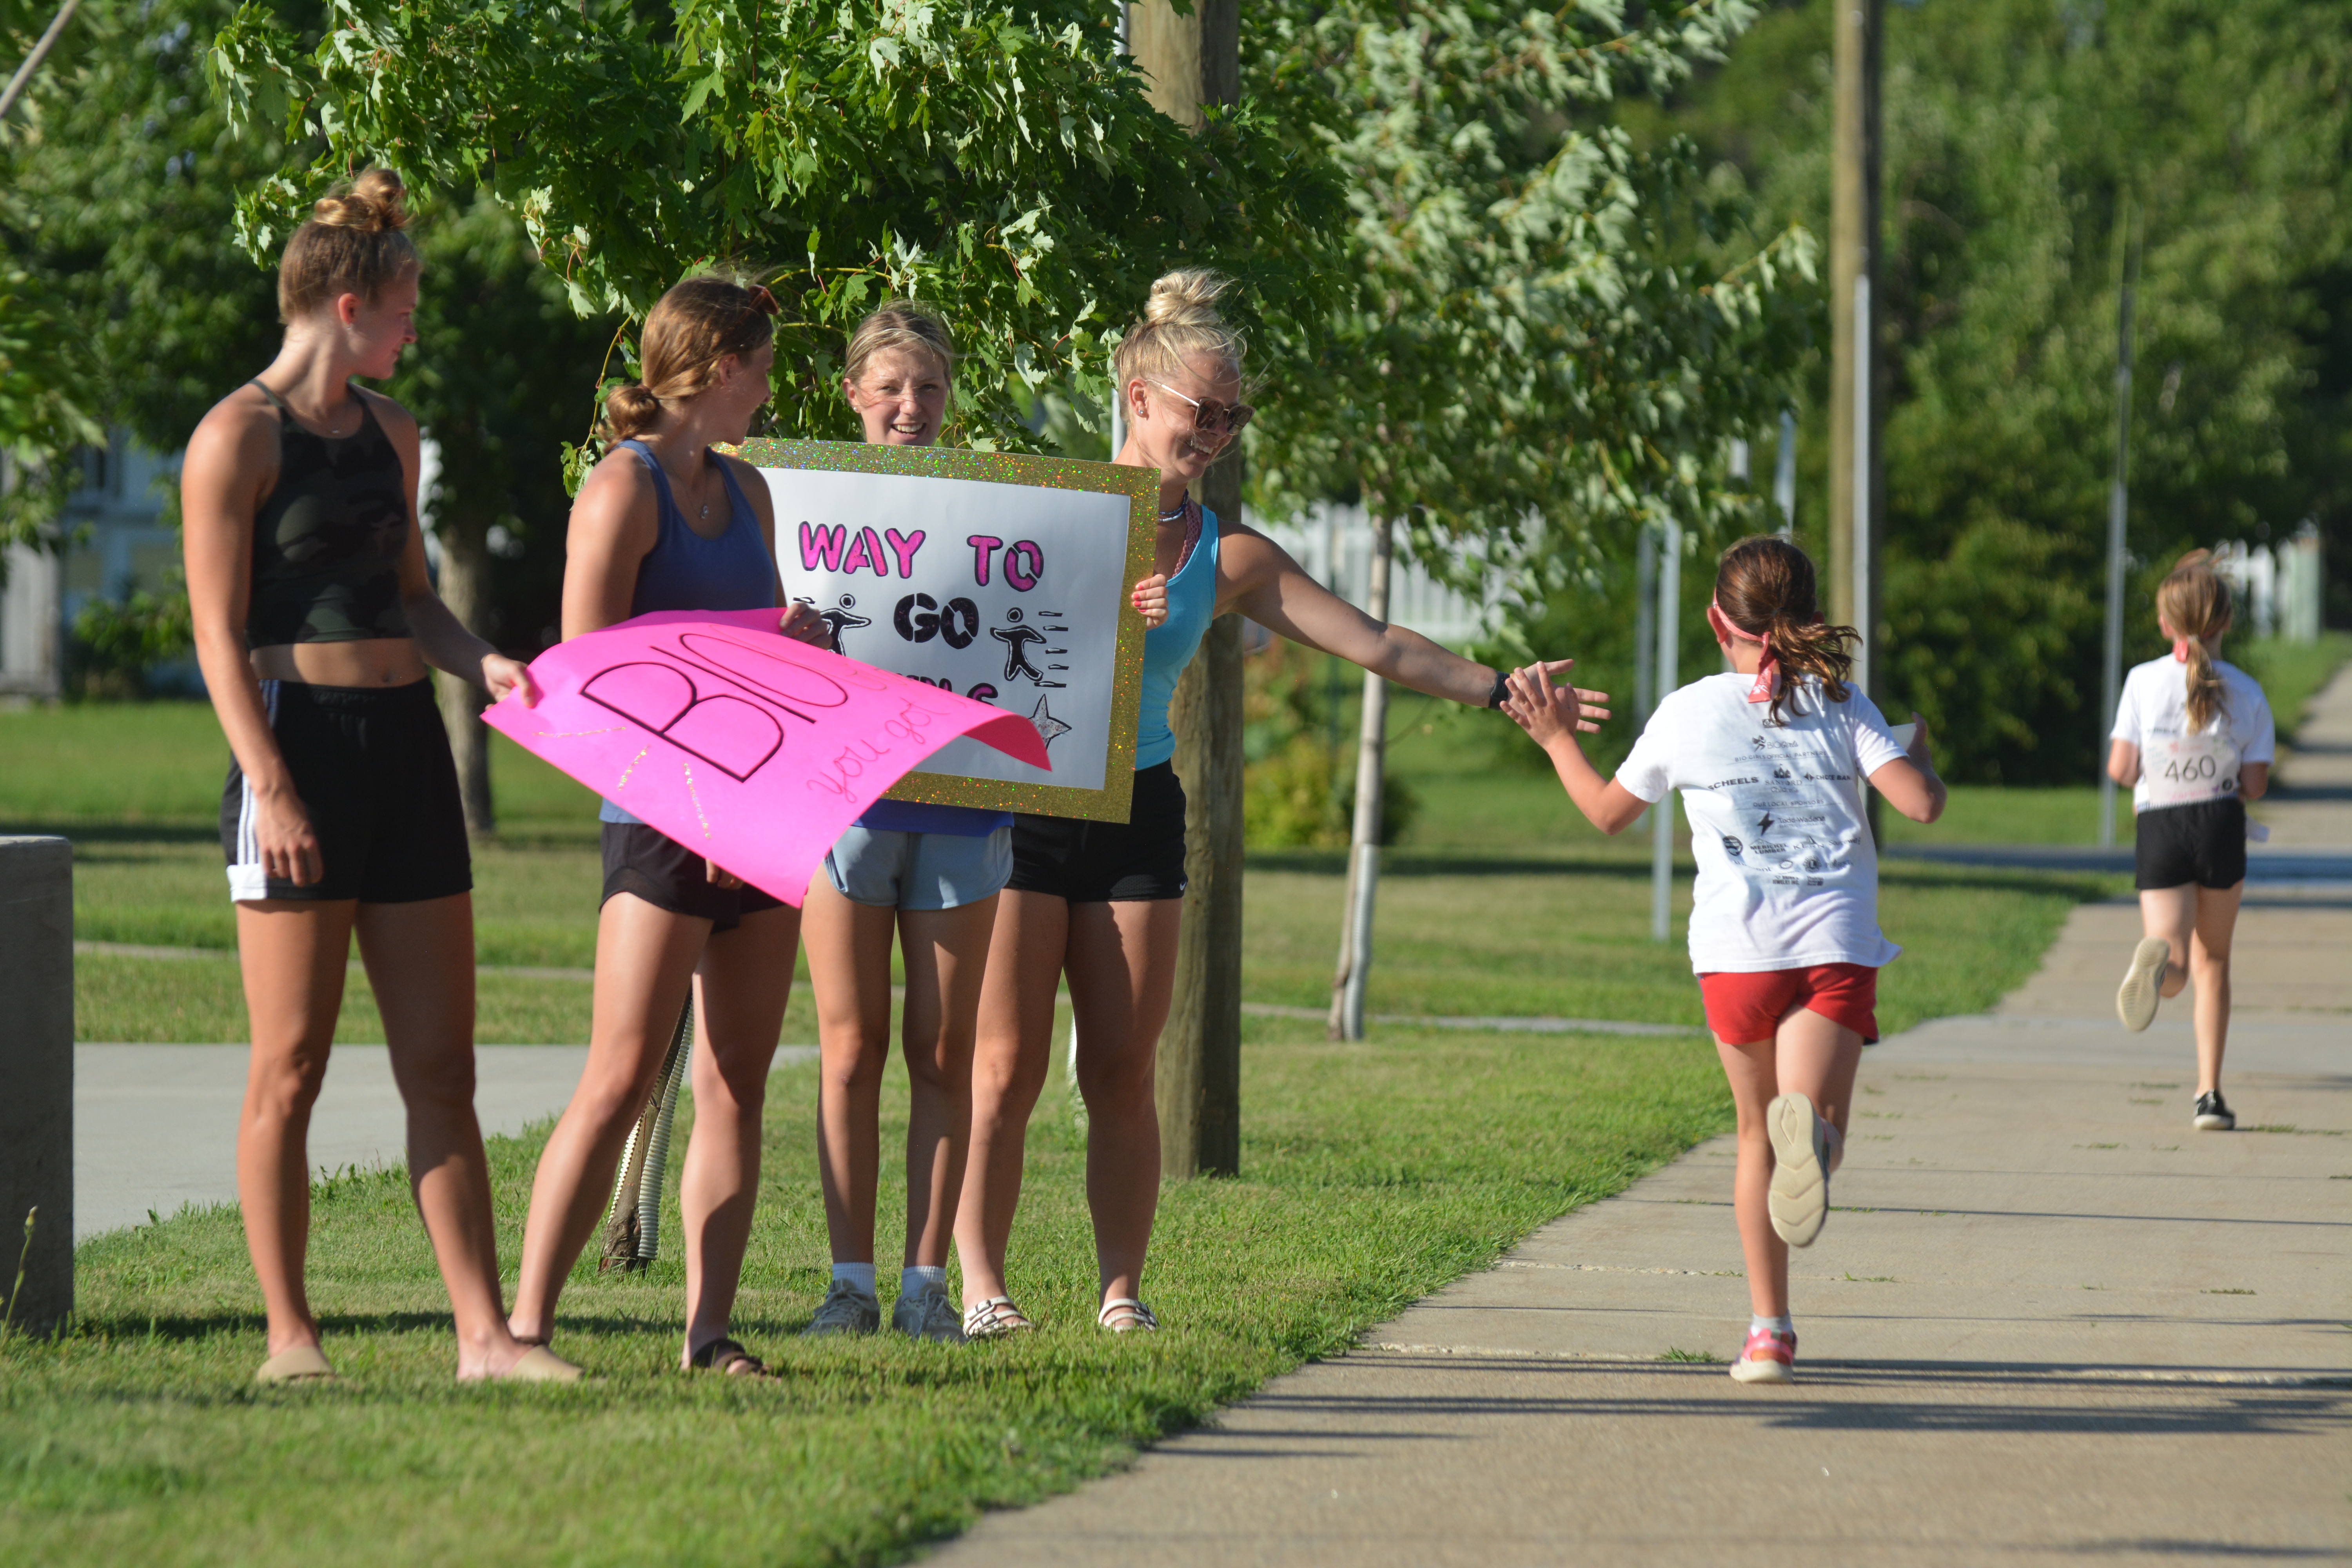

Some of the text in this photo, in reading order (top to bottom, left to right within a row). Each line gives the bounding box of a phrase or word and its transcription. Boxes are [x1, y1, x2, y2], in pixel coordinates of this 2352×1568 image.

[798, 521, 1044, 592] WAY TO
[893, 593, 980, 650] GO
[579, 633, 849, 783] BIO
[806, 739, 891, 803] you
[1707, 777, 1760, 791] SCHEELS
[2165, 754, 2217, 783] 460
